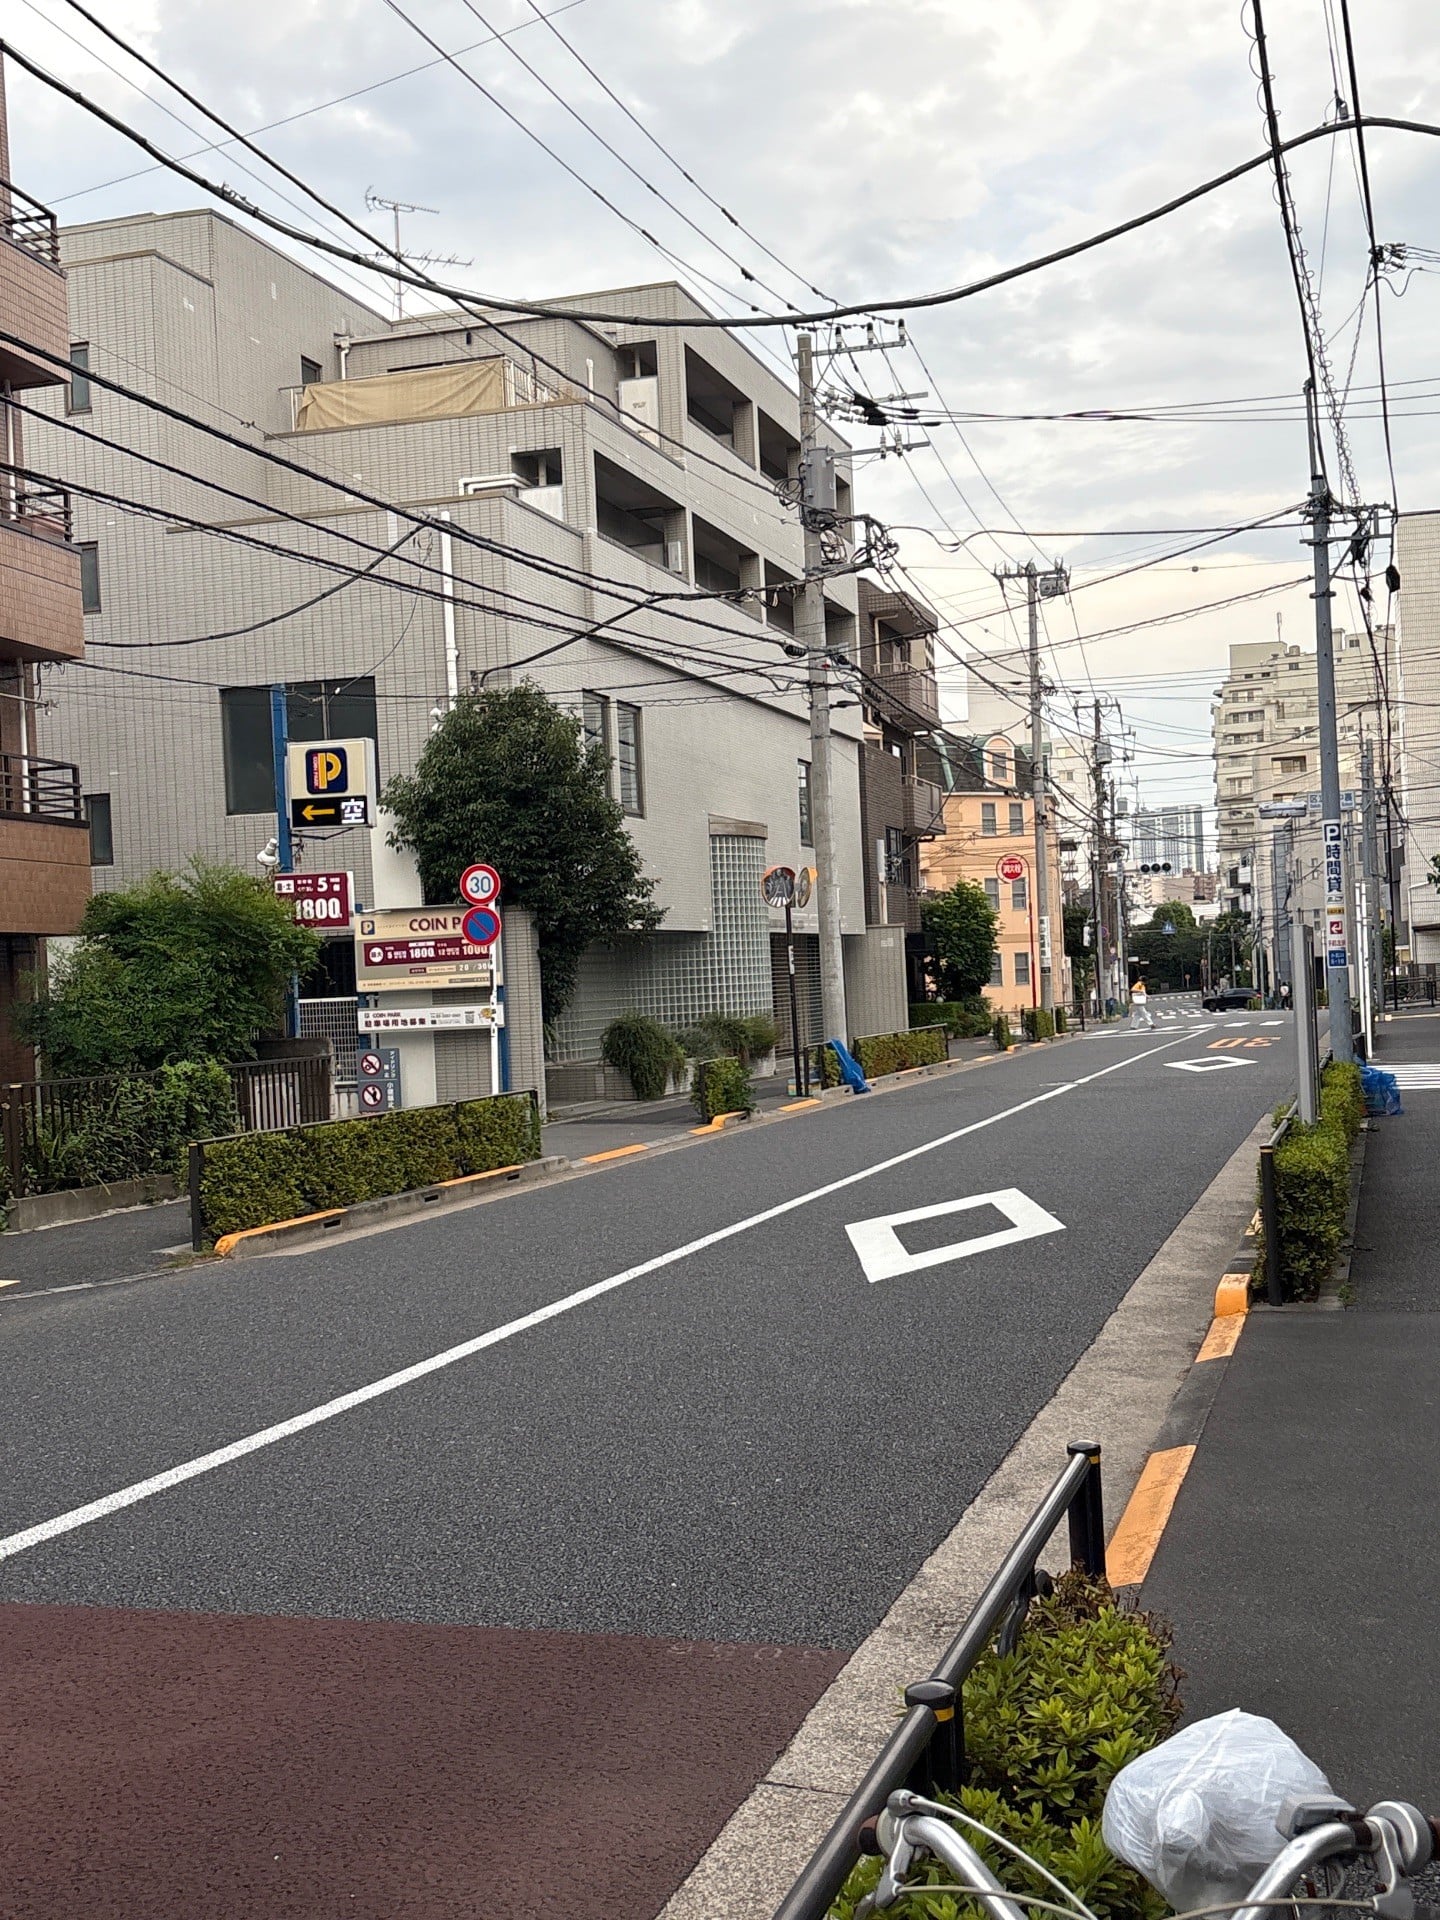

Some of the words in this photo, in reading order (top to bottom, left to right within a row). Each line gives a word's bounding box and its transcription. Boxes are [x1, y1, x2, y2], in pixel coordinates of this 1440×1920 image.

[341, 798, 365, 824] 空
[1326, 844, 1342, 893] 時間貸
[317, 877, 328, 892] 5
[470, 876, 491, 894] 30
[295, 897, 340, 920] 1800
[409, 917, 447, 932] COIN
[364, 1018, 426, 1028] 駐車場用地募集
